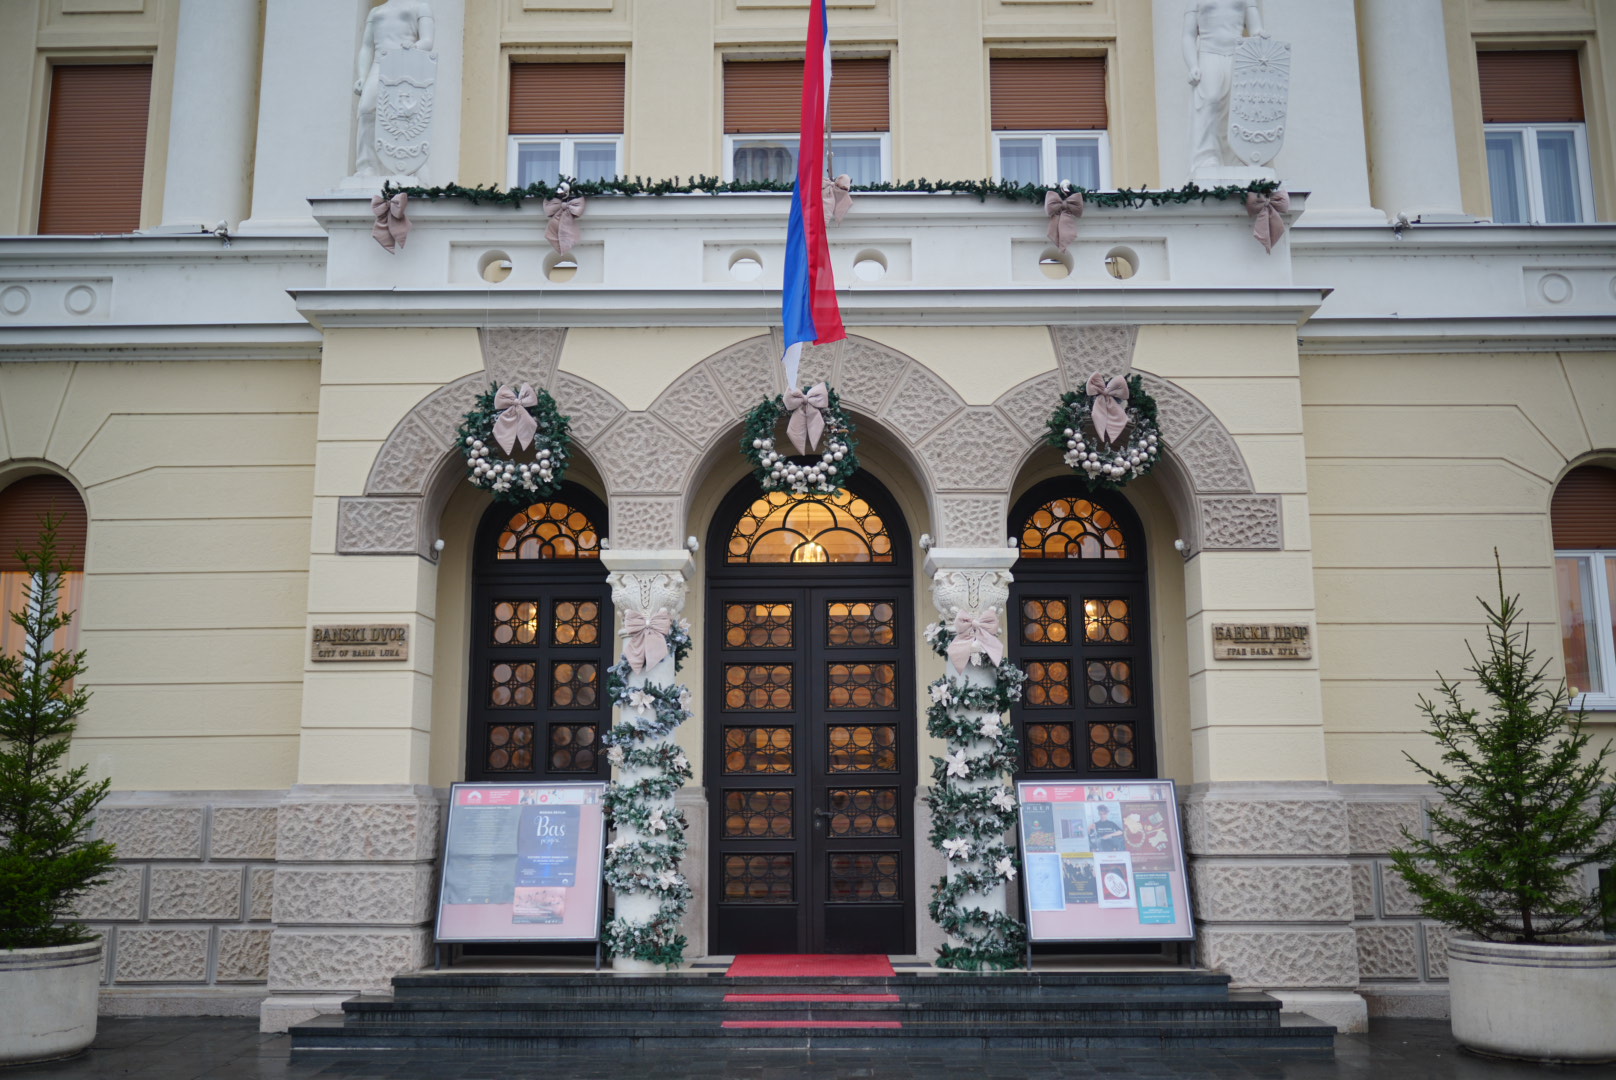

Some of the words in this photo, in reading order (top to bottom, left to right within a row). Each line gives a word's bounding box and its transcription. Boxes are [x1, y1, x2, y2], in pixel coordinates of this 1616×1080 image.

[313, 628, 366, 642] BANSKI
[370, 627, 405, 641] DVOR
[1215, 626, 1270, 641] БАНСКИ
[1274, 626, 1308, 641] ДВОР
[318, 650, 336, 658] CITY
[380, 649, 400, 657] LUKA
[1227, 648, 1247, 656] ГРАД
[1250, 648, 1274, 656] БАЊА
[1278, 648, 1299, 656] ЛУКА
[535, 815, 566, 837] Bas
